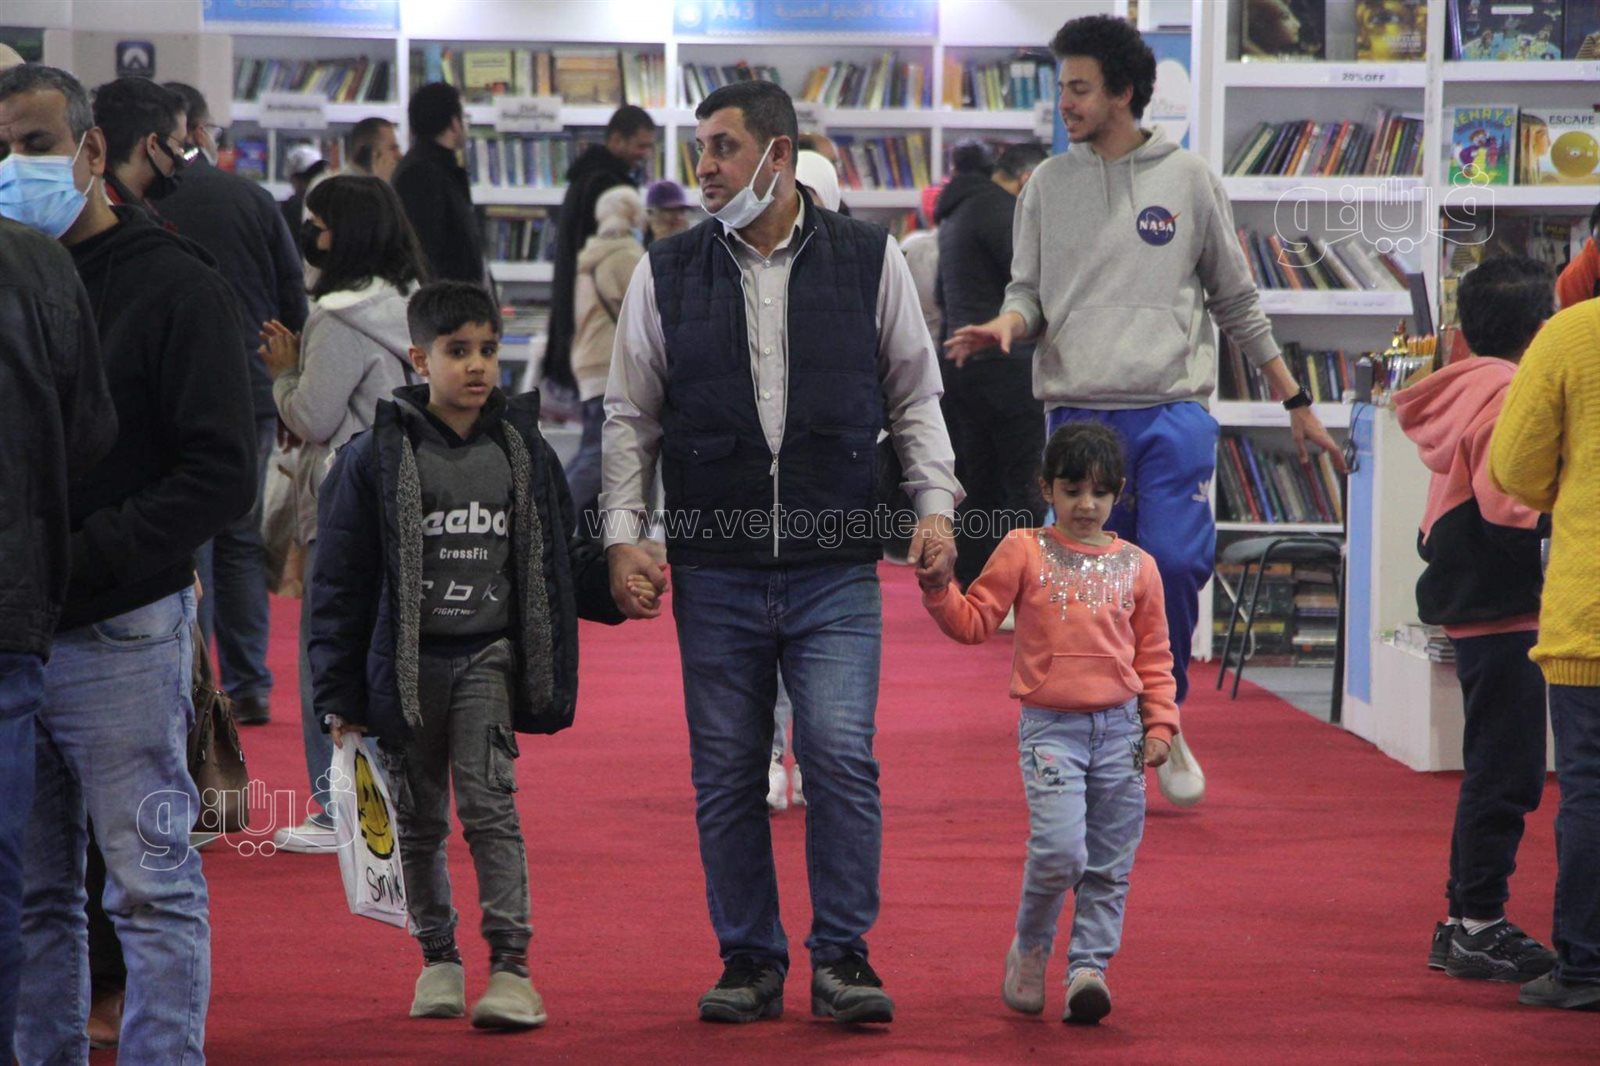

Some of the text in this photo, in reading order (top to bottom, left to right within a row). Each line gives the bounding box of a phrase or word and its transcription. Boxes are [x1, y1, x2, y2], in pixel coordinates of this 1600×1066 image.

[1549, 114, 1596, 126] ESCAPE
[1140, 220, 1174, 232] NASA
[422, 501, 510, 538] eebo
[439, 547, 489, 561] CrossFit
